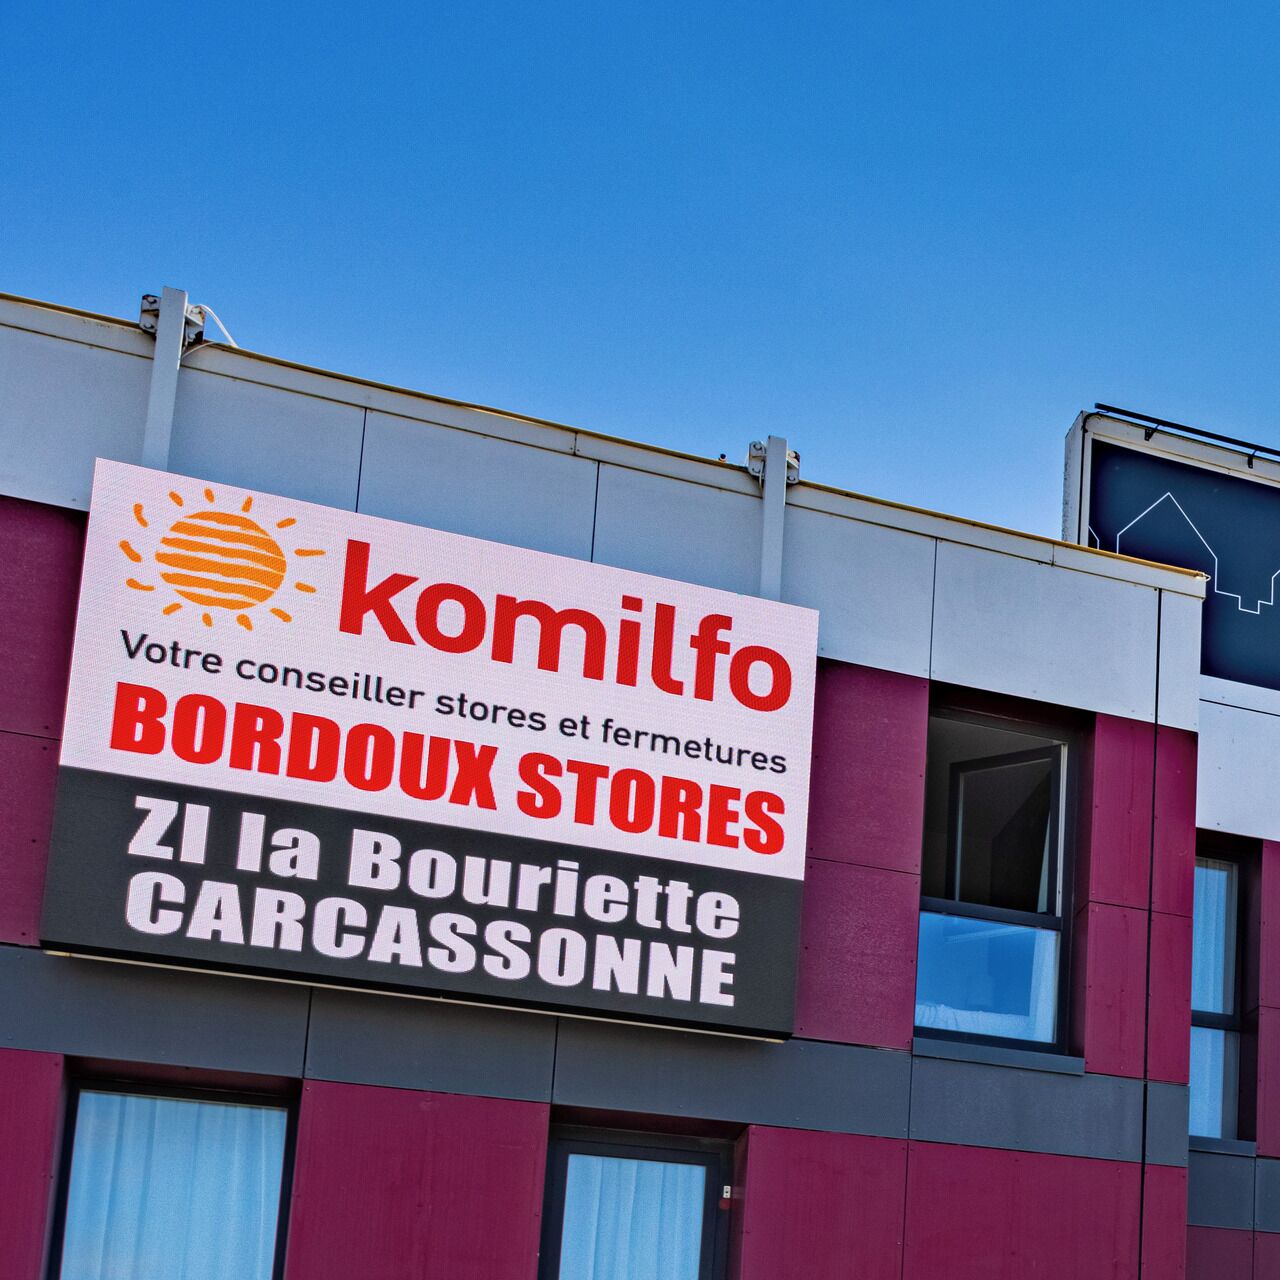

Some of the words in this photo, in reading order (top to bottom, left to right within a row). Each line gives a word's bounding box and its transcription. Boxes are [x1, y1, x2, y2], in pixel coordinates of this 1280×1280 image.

[339, 539, 793, 713] komilfo
[109, 681, 500, 812] BORDOUX
[517, 750, 786, 857] STORES
[120, 629, 224, 676] Votre
[236, 656, 427, 711] conseiller
[435, 689, 547, 735] stores
[558, 710, 590, 740] et
[601, 717, 787, 775] fermetures
[126, 796, 211, 865] ZI
[237, 812, 321, 882] la
[348, 831, 741, 941] Bouriette
[126, 871, 737, 1009] CARCASSONNE
